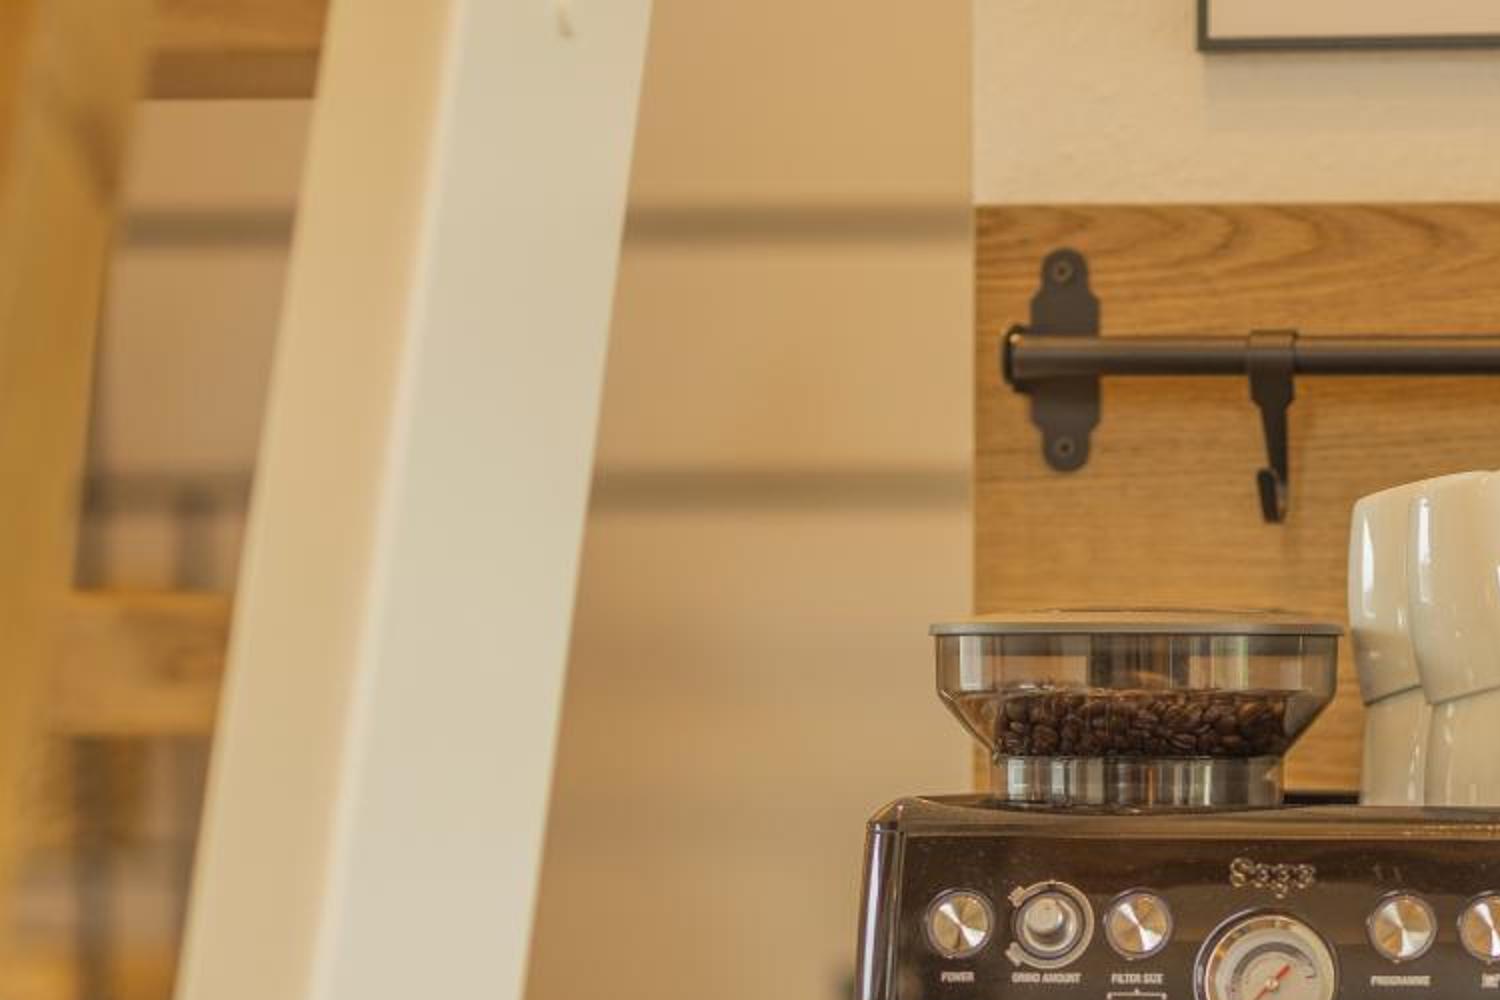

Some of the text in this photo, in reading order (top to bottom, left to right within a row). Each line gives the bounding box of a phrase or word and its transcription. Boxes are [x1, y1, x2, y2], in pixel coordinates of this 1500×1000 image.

[1230, 857, 1315, 899] Sage
[941, 971, 975, 983] POWER
[1111, 973, 1141, 984] FILTER
